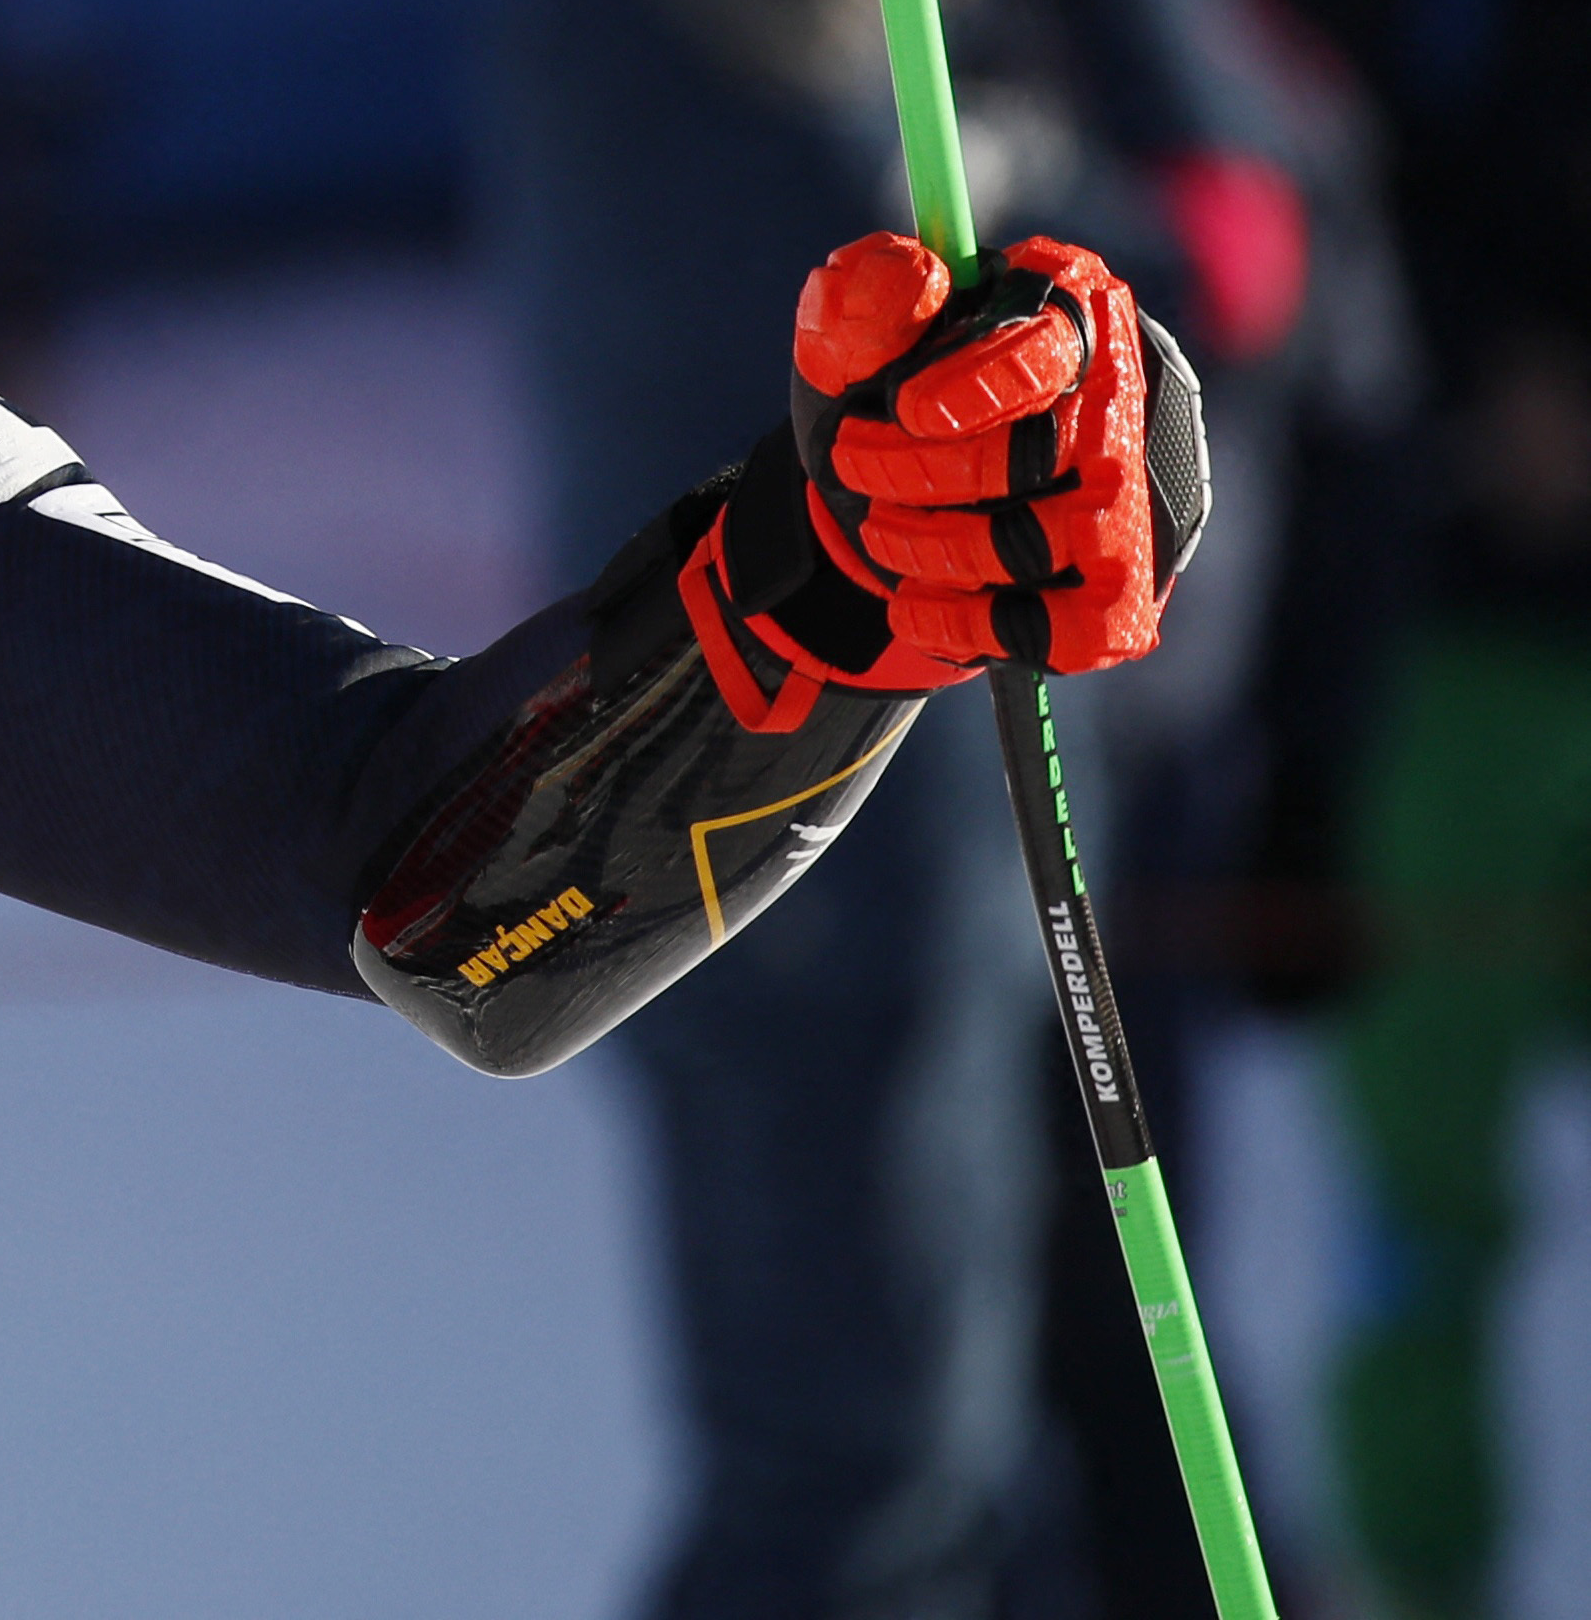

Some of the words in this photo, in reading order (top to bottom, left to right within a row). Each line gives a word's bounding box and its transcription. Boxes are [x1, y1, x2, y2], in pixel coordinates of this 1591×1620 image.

[1036, 672, 1088, 898] ERDELL
[457, 886, 595, 988] DANÇAR
[1042, 899, 1120, 1104] KOMPERDELL
